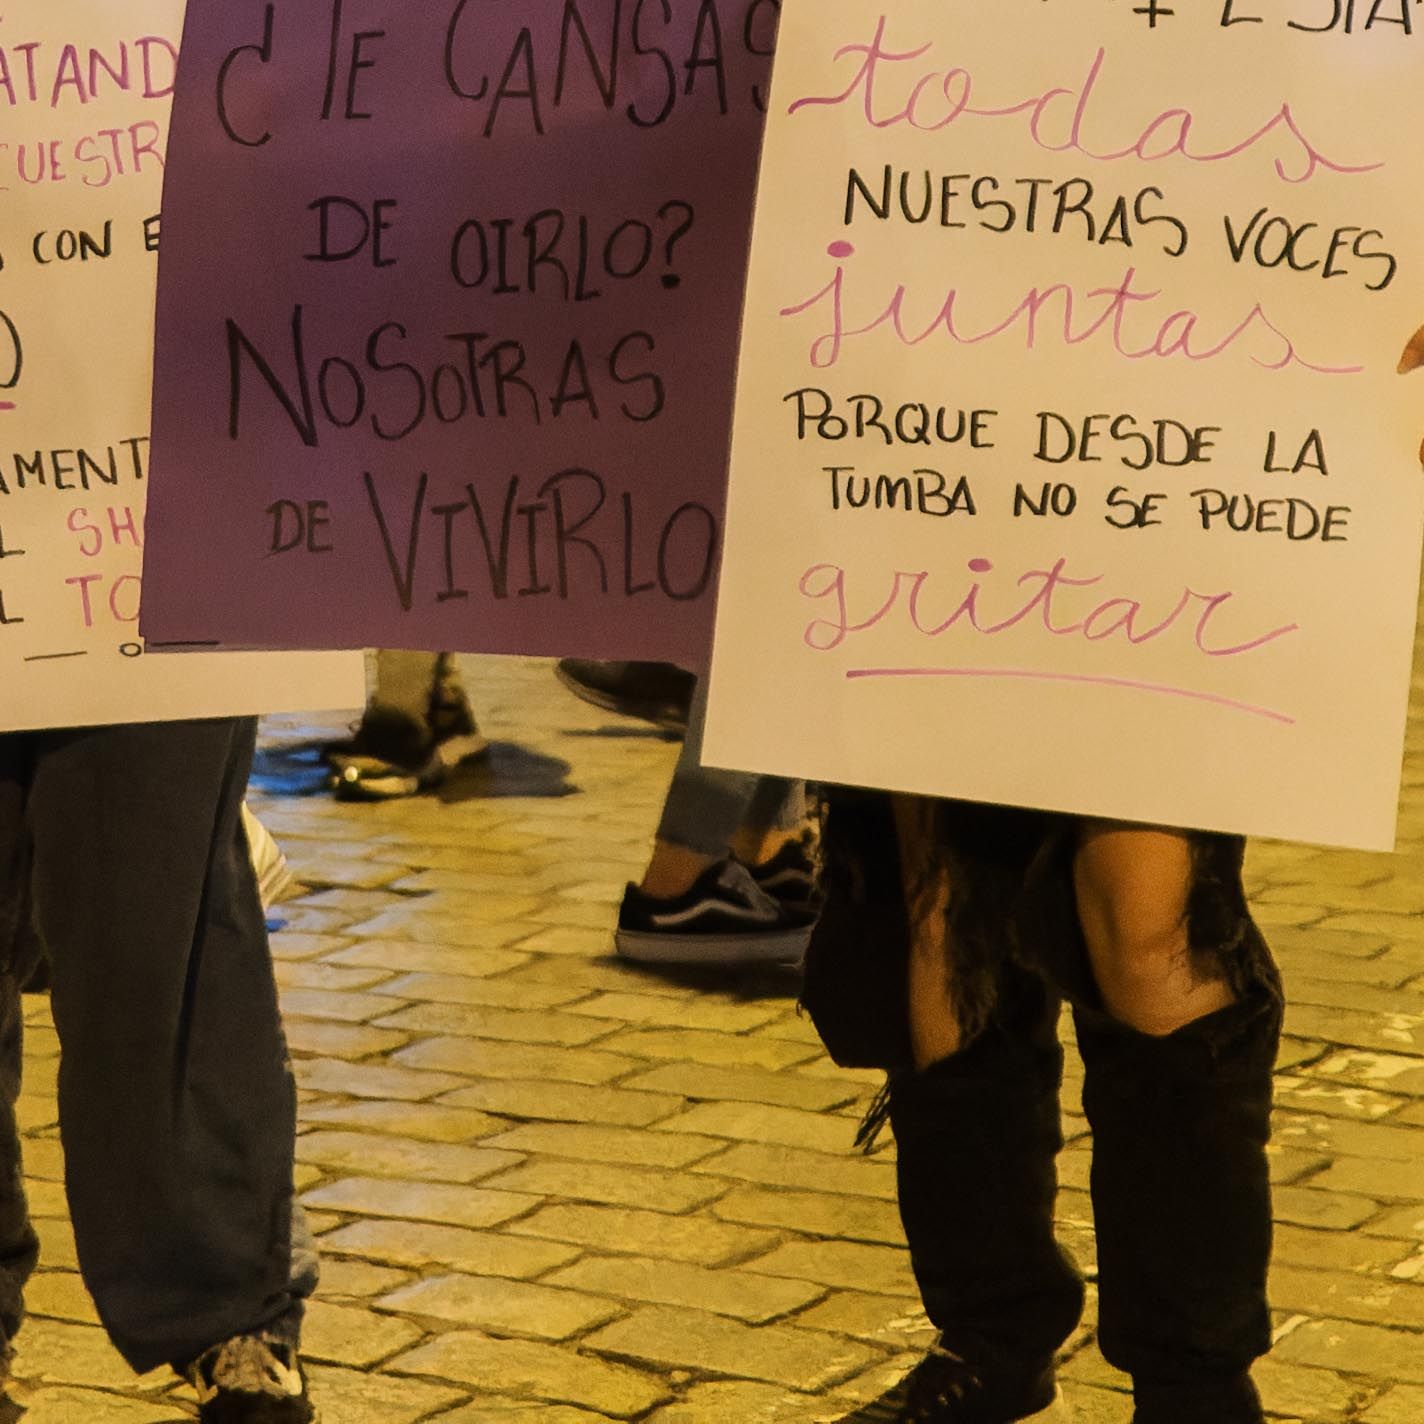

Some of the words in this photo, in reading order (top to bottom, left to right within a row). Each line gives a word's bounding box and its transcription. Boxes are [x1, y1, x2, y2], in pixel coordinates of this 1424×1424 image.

[786, 12, 1386, 184] todas
[30, 218, 114, 266] CON
[142, 213, 162, 252] E
[304, 198, 397, 266] DE
[450, 198, 696, 302] OIRLO?
[842, 164, 1188, 260] NUESTRAS
[1222, 210, 1400, 292] VOCES
[778, 238, 1366, 370] juntas
[225, 304, 666, 447] NOSOTRAS
[782, 386, 1000, 452] PORQUE
[1032, 408, 1224, 470] DESDE
[1262, 426, 1330, 476] LA
[66, 506, 146, 558] SH
[266, 500, 334, 558] DE
[362, 468, 718, 612] VIVIRLO
[822, 464, 978, 518] TUMBA
[1010, 480, 1076, 522] NO
[1104, 484, 1166, 530] SE
[1192, 488, 1352, 544] PUEDE
[64, 574, 142, 627] TO
[796, 556, 1302, 656] gritar
